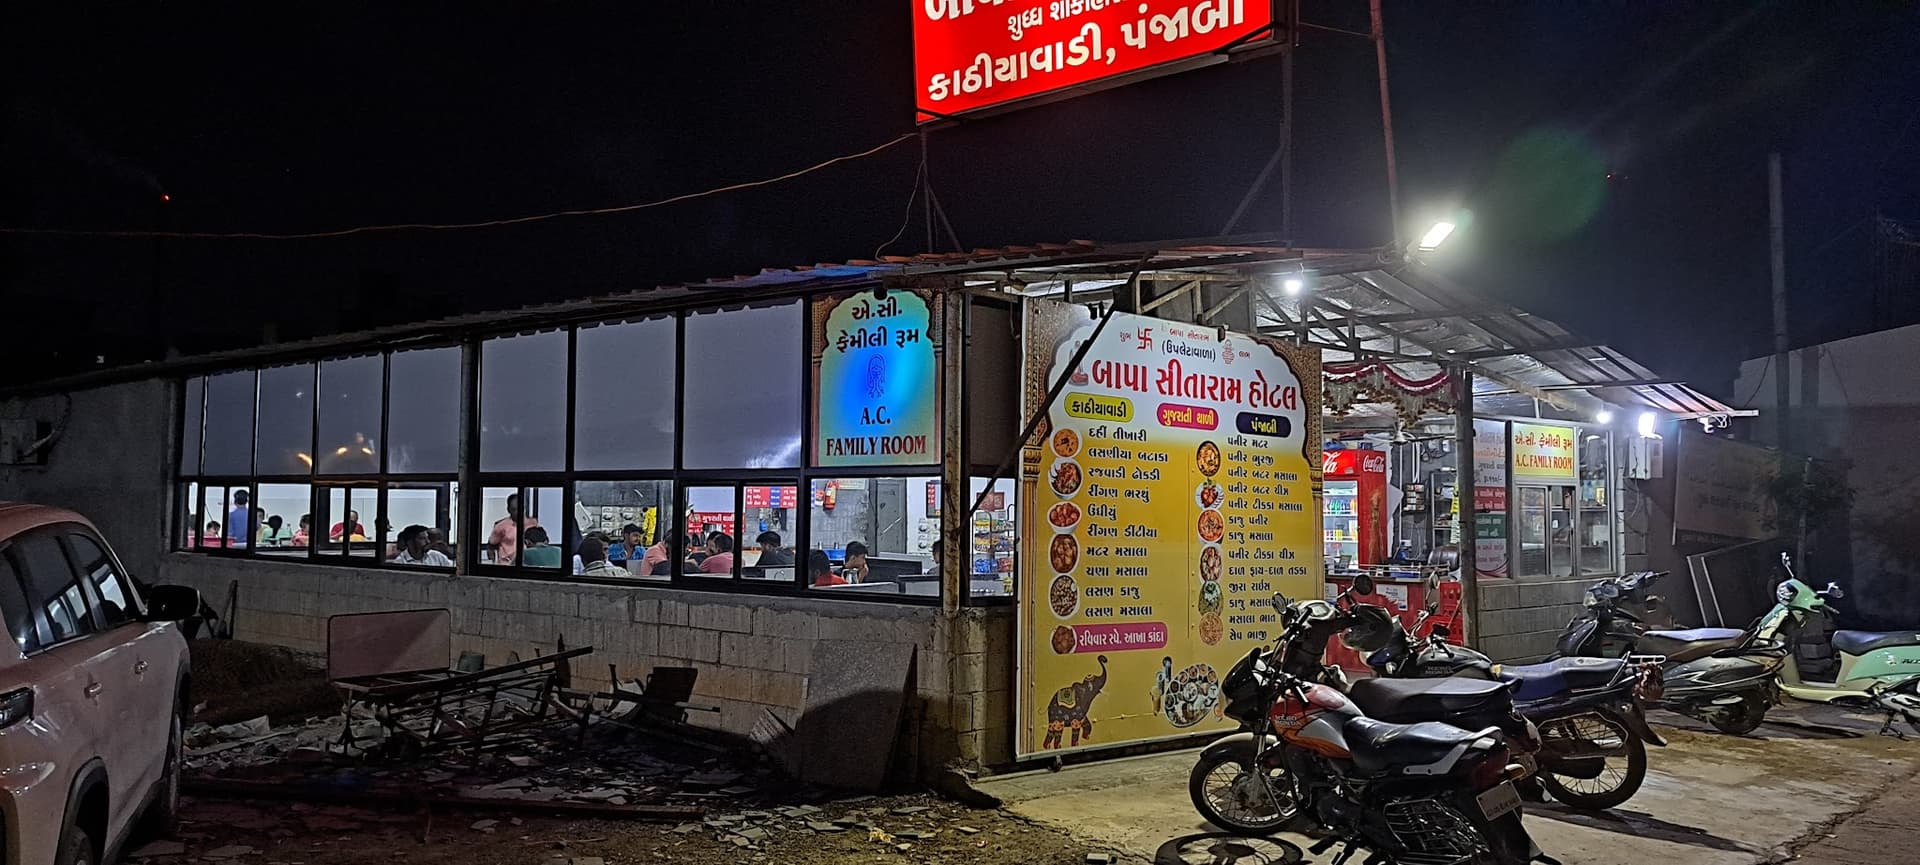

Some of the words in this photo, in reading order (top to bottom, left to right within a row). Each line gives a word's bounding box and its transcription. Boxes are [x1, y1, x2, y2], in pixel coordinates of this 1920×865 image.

[836, 326, 887, 353] ફેમીલી
[896, 328, 919, 348] રૂમ
[1092, 359, 1148, 392] બાપા
[1156, 358, 1242, 404] સીતારામ
[1248, 369, 1297, 410] હોટલ
[1071, 397, 1126, 418] કાઠીયાવાડી
[860, 406, 891, 425] A.C.
[1162, 407, 1192, 426] ગુજરાતી
[1250, 416, 1277, 434] પંજાબી
[1113, 426, 1147, 441] તીખારી
[826, 436, 878, 456] FAMILY
[881, 435, 926, 455] ROOM
[1227, 434, 1247, 446] પનીર
[1251, 440, 1268, 448] મટર
[1088, 446, 1131, 459] લસણીયા
[1138, 453, 1168, 462] બટાકા
[1227, 450, 1247, 462] પનીર
[1516, 454, 1529, 467] A.C.
[1530, 455, 1553, 469] FAMILY
[1554, 456, 1572, 470] ROOM
[1088, 466, 1125, 479] રજવાડી
[1228, 466, 1248, 478] પનીર
[1252, 469, 1269, 479] બટર
[1274, 472, 1297, 481] મસાલા
[1228, 481, 1248, 493] પનીર
[1252, 485, 1270, 495] બટર
[1228, 497, 1248, 508] પનીર
[1278, 502, 1302, 511] મસાલા
[1228, 515, 1244, 528] કાજુ
[1249, 514, 1268, 525] પનીર
[1228, 532, 1244, 544] કાજુ
[1249, 532, 1273, 541] મસાલા
[1086, 547, 1109, 556] મટર
[1115, 546, 1147, 557] મસાલા
[1228, 547, 1249, 559] પનીર
[1086, 566, 1109, 576] ચણા
[1116, 566, 1147, 576] મસાલા
[1228, 566, 1245, 576] દાળ
[1085, 586, 1114, 597] લસણ
[1120, 586, 1141, 599] કાજુ
[1085, 606, 1113, 617] લસણ
[1120, 606, 1152, 616] મસાલા
[1229, 600, 1245, 611] કાજુ
[1250, 599, 1273, 607] મસાલ
[1229, 615, 1255, 624] મસાલા
